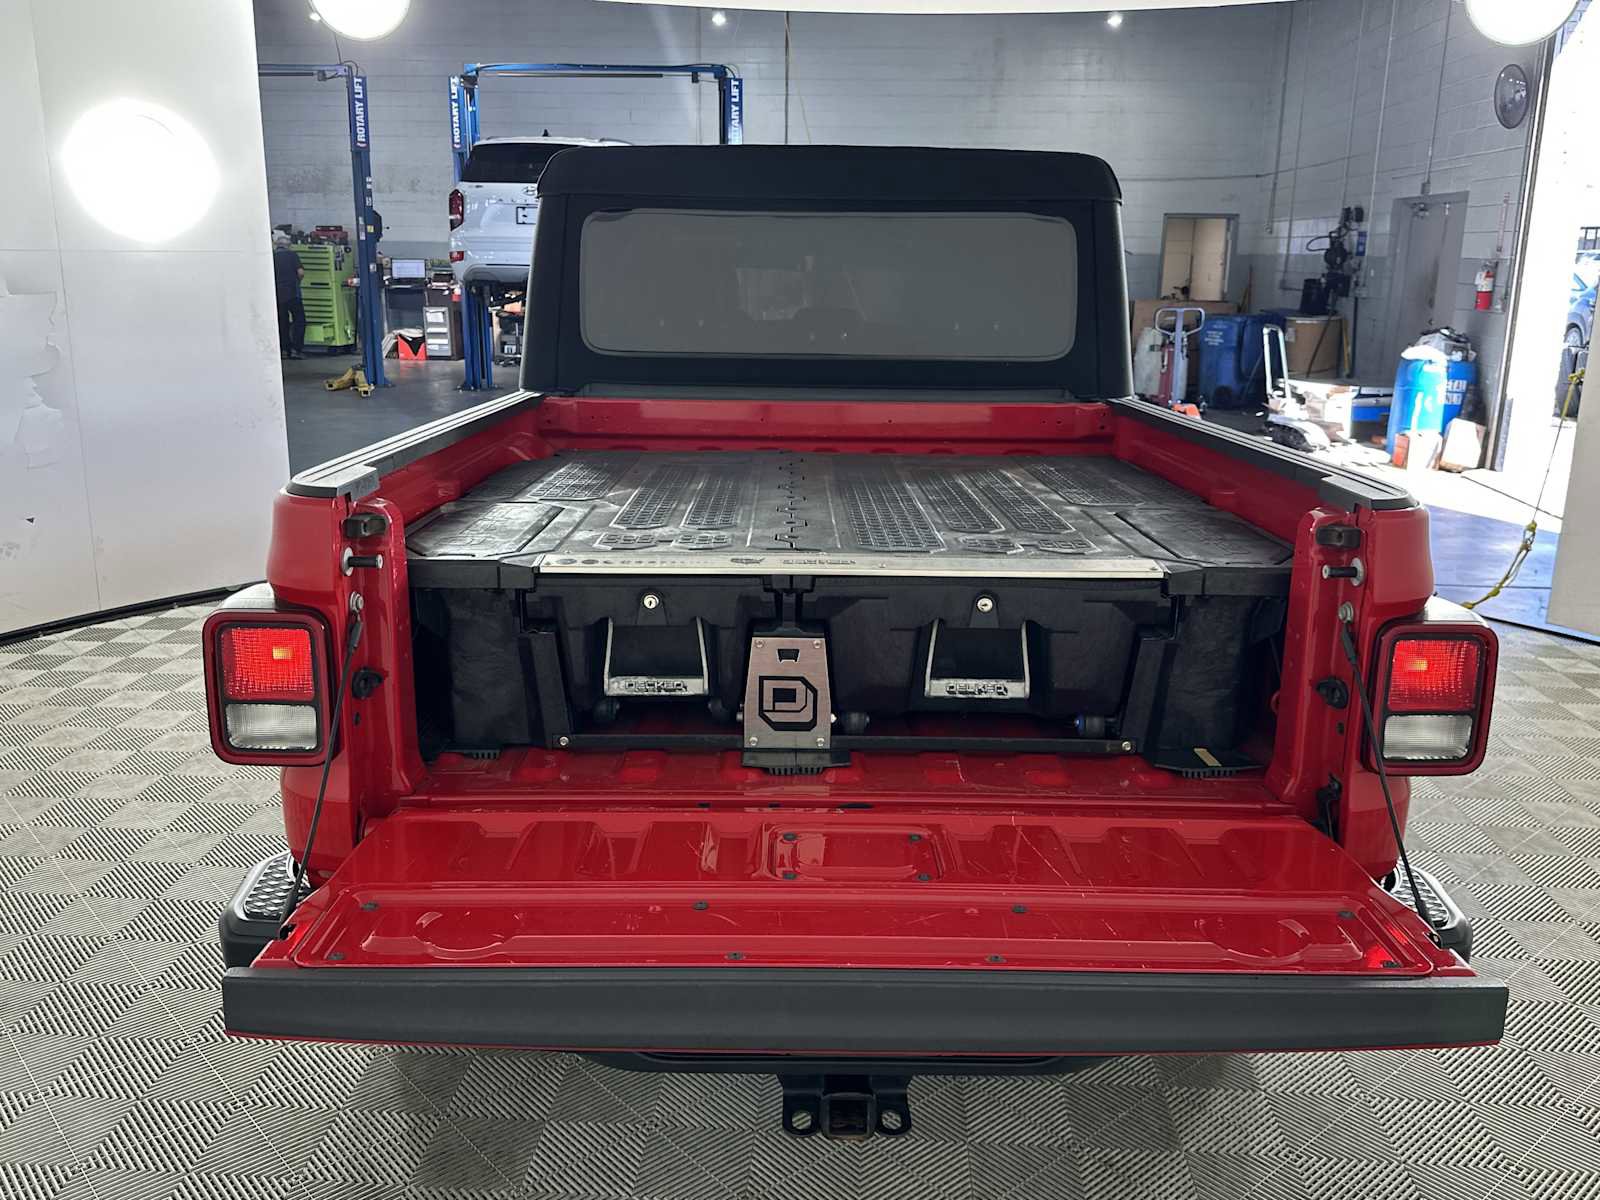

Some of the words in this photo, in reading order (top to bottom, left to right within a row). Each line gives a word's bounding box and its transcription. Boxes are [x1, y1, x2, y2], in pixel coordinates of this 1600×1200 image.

[353, 77, 363, 98] LIFT
[731, 79, 740, 102] LIFT
[355, 100, 366, 142] ROTARY
[451, 101, 460, 143] ROTARY
